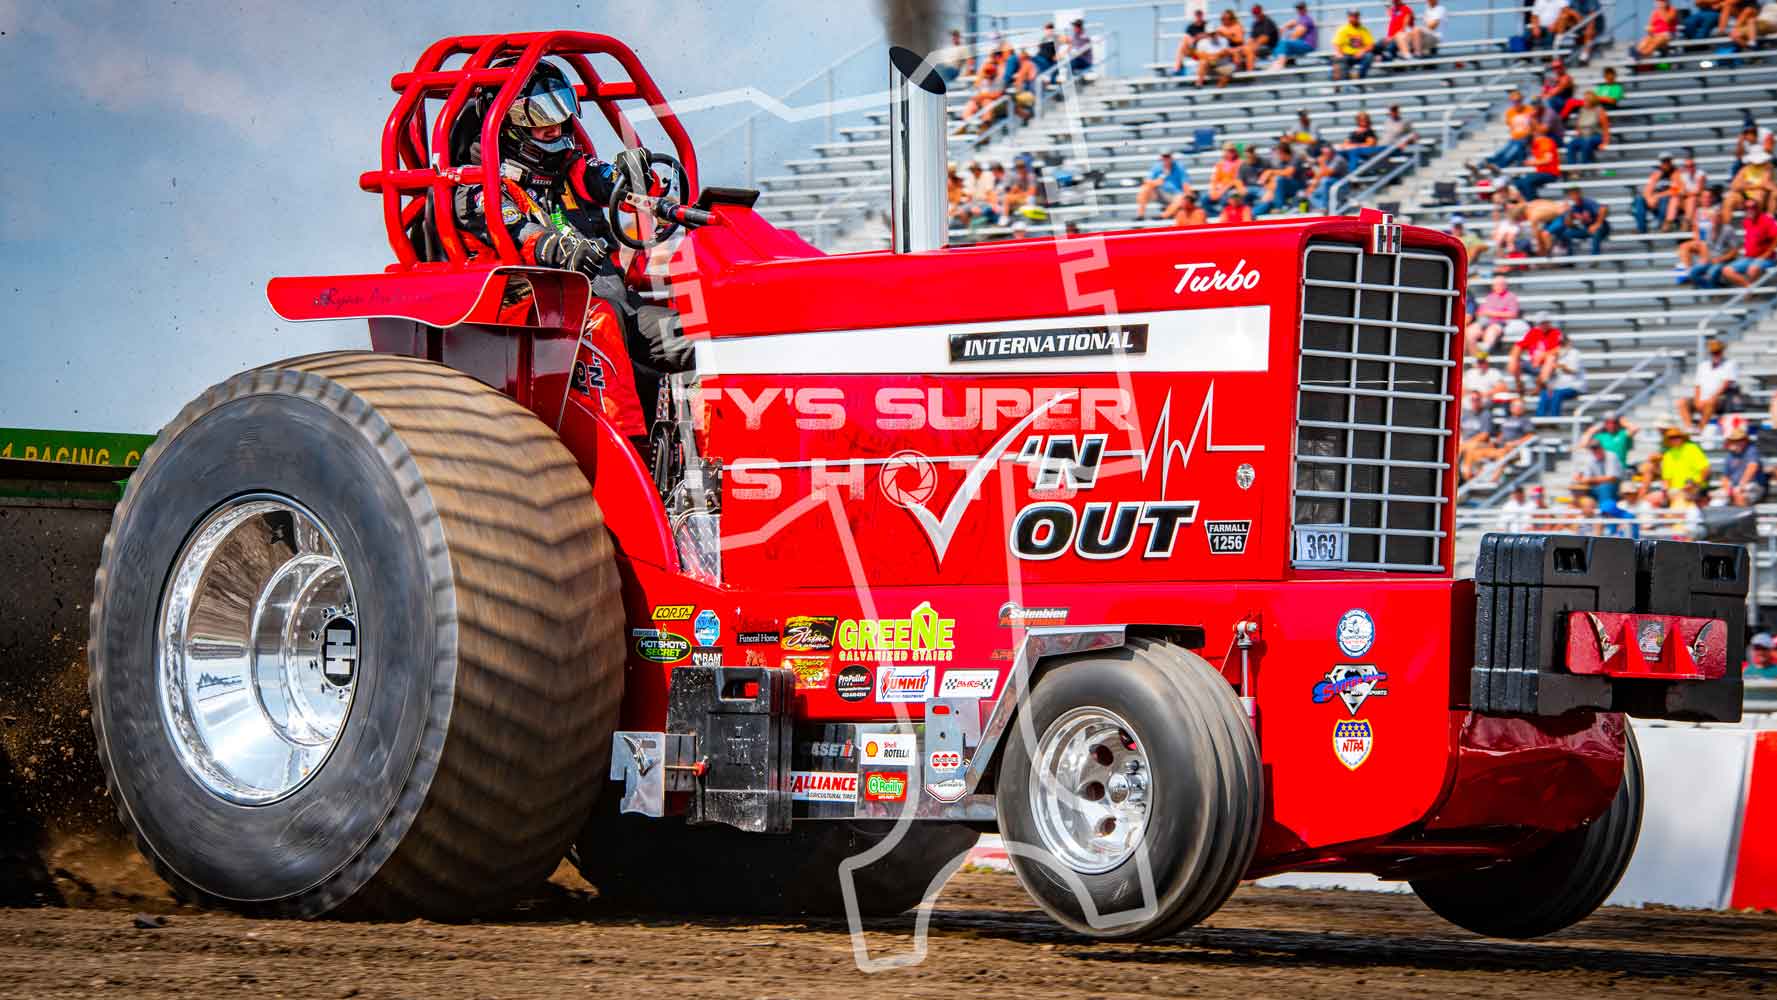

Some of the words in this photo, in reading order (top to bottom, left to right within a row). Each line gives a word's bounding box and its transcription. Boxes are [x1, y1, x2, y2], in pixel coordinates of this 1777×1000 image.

[1174, 259, 1260, 294] Turbo
[964, 331, 1133, 357] INTERNATIONAL
[24, 446, 110, 465] RACING
[1009, 500, 1200, 560] OUT
[1209, 524, 1247, 533] FARMALL
[1213, 535, 1242, 550] 1256
[1306, 534, 1337, 560] 363
[655, 607, 691, 618] CORSA
[839, 600, 955, 650] GREENE
[739, 633, 760, 642] Funeral
[761, 633, 778, 642] Home
[645, 647, 682, 657] SECRET
[658, 641, 687, 650] SHOT'S
[702, 652, 721, 662] RAM
[839, 650, 908, 661] GALVANIZED
[912, 650, 953, 661] STAIRS
[1342, 739, 1364, 752] NTPA
[883, 748, 910, 758] ROTELLA
[792, 775, 857, 792] ALLIANCE
[869, 777, 903, 794] O'Reilly
